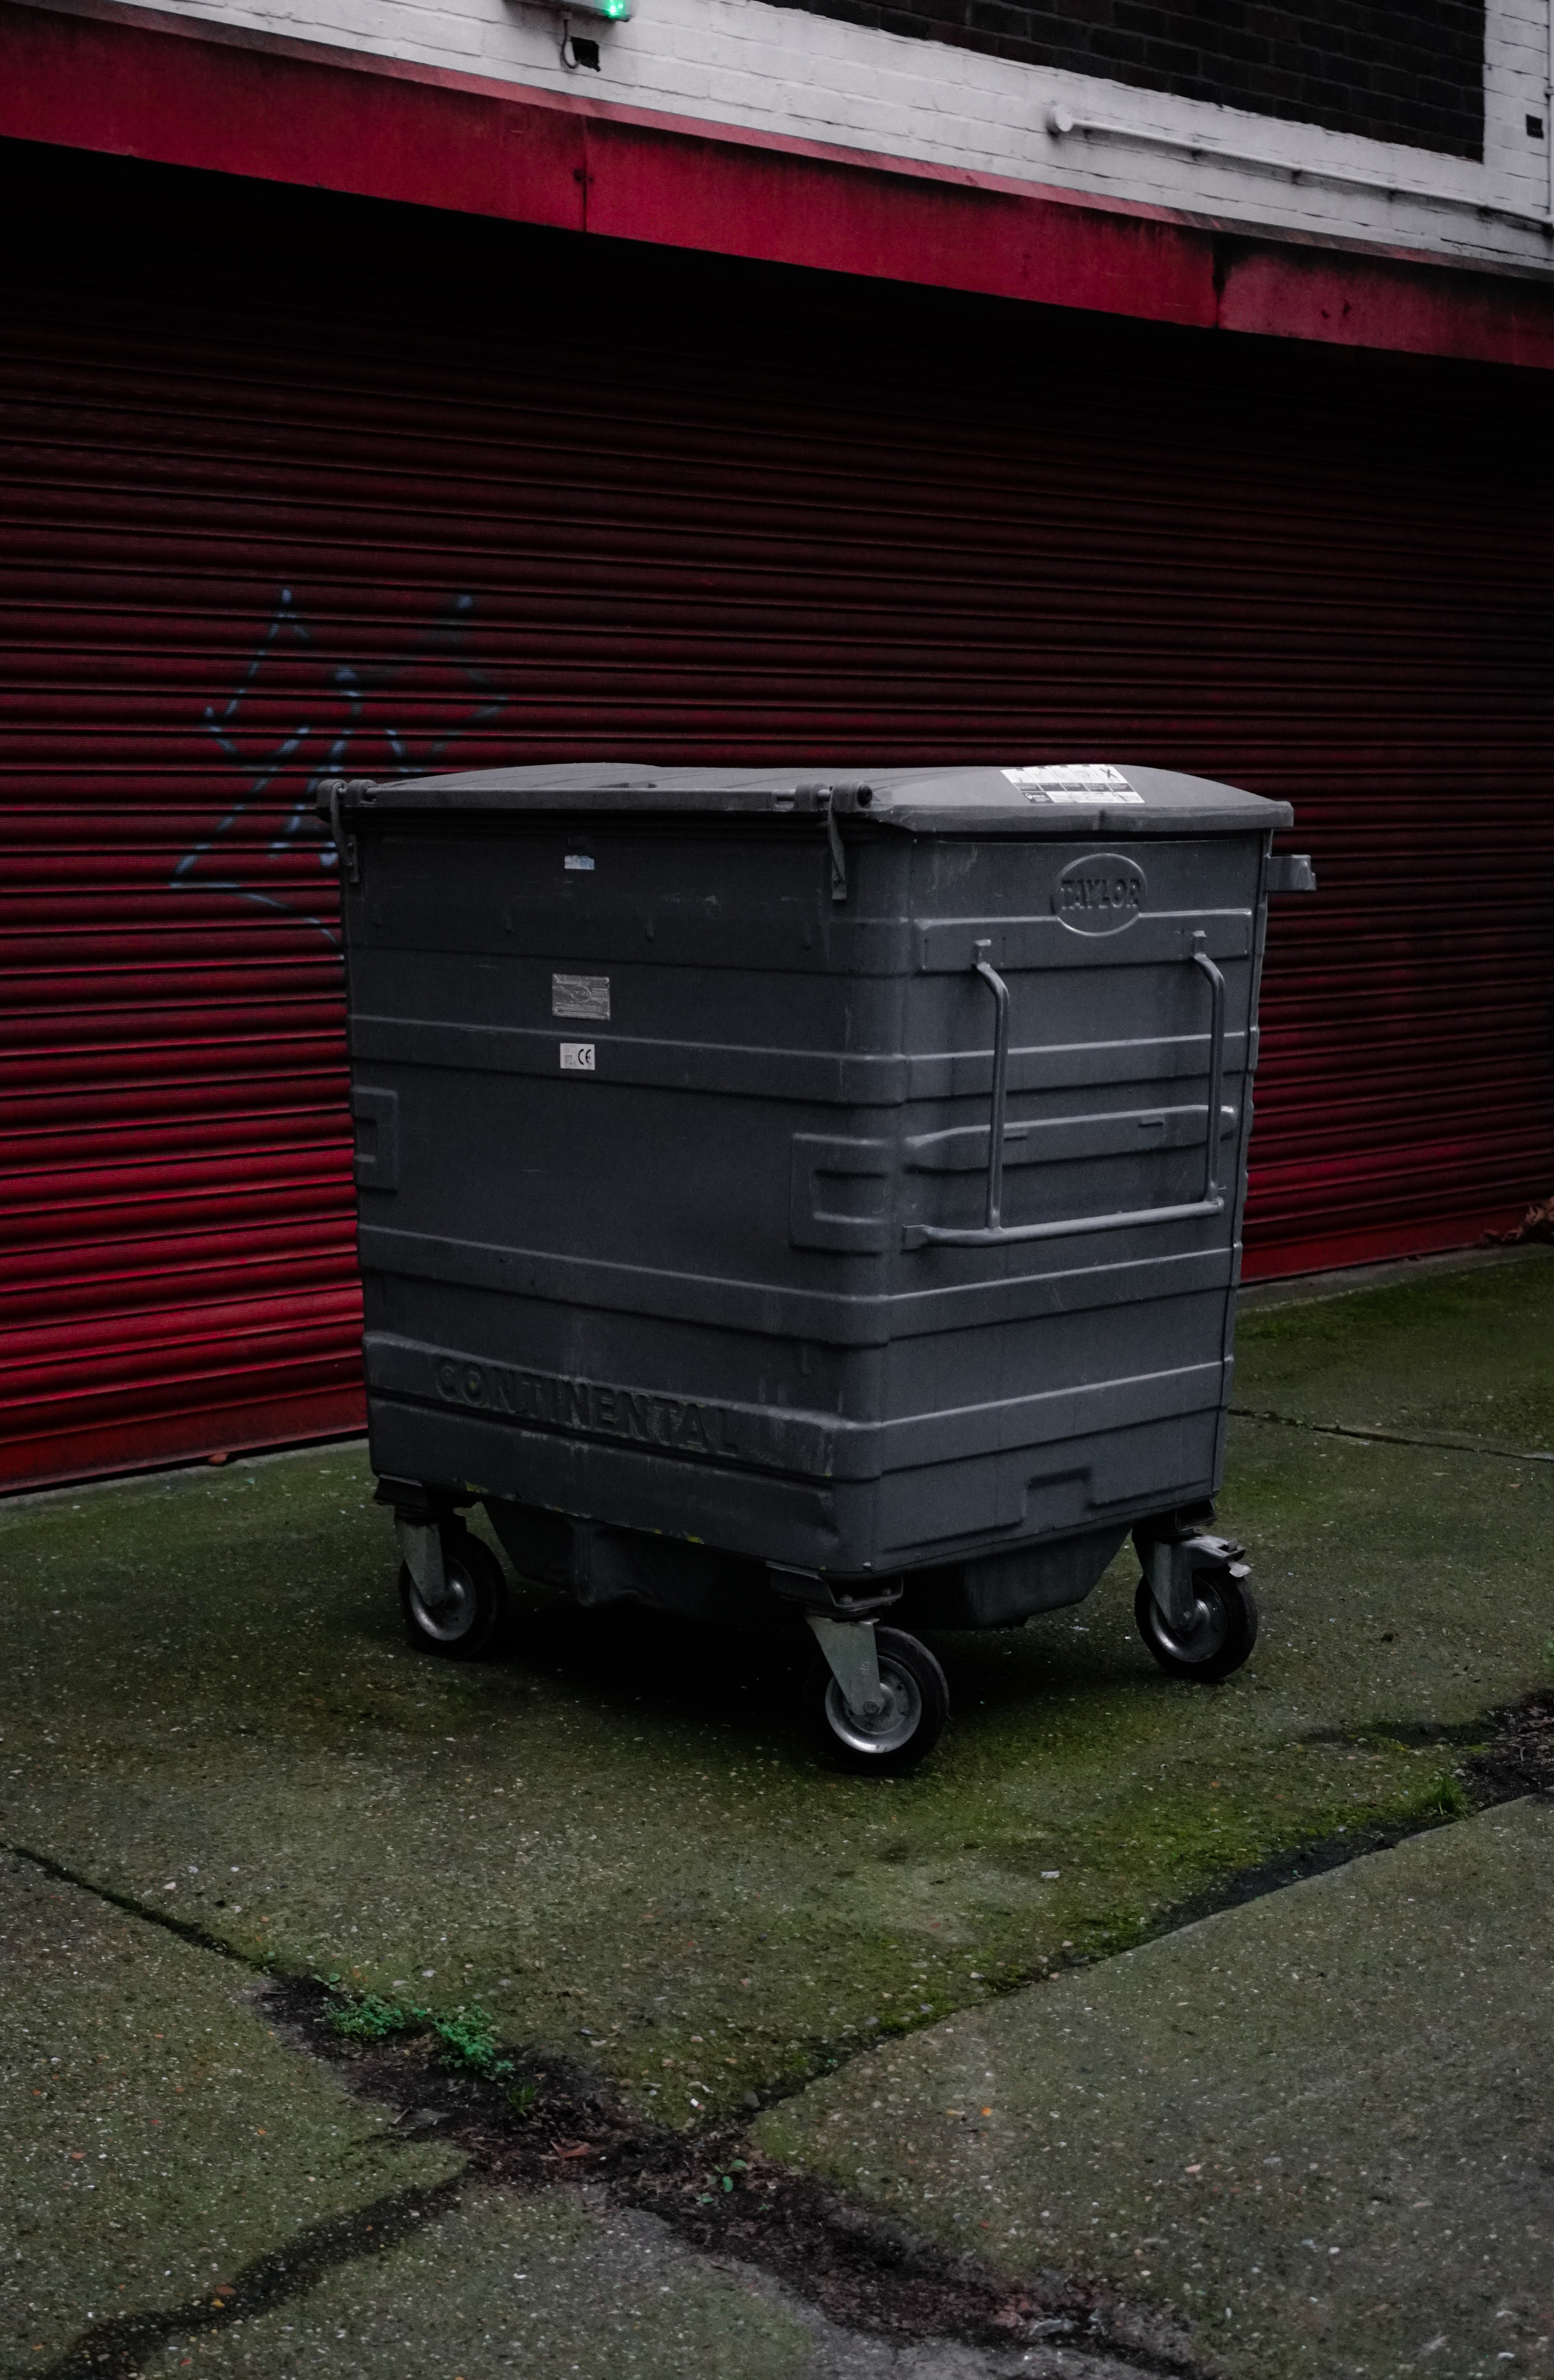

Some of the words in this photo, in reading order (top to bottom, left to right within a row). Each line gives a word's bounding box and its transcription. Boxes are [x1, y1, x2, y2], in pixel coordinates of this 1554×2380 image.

[1060, 878, 1141, 910] TAYLOR
[578, 1048, 591, 1065] CE
[435, 1357, 740, 1457] CONTINENTAL
